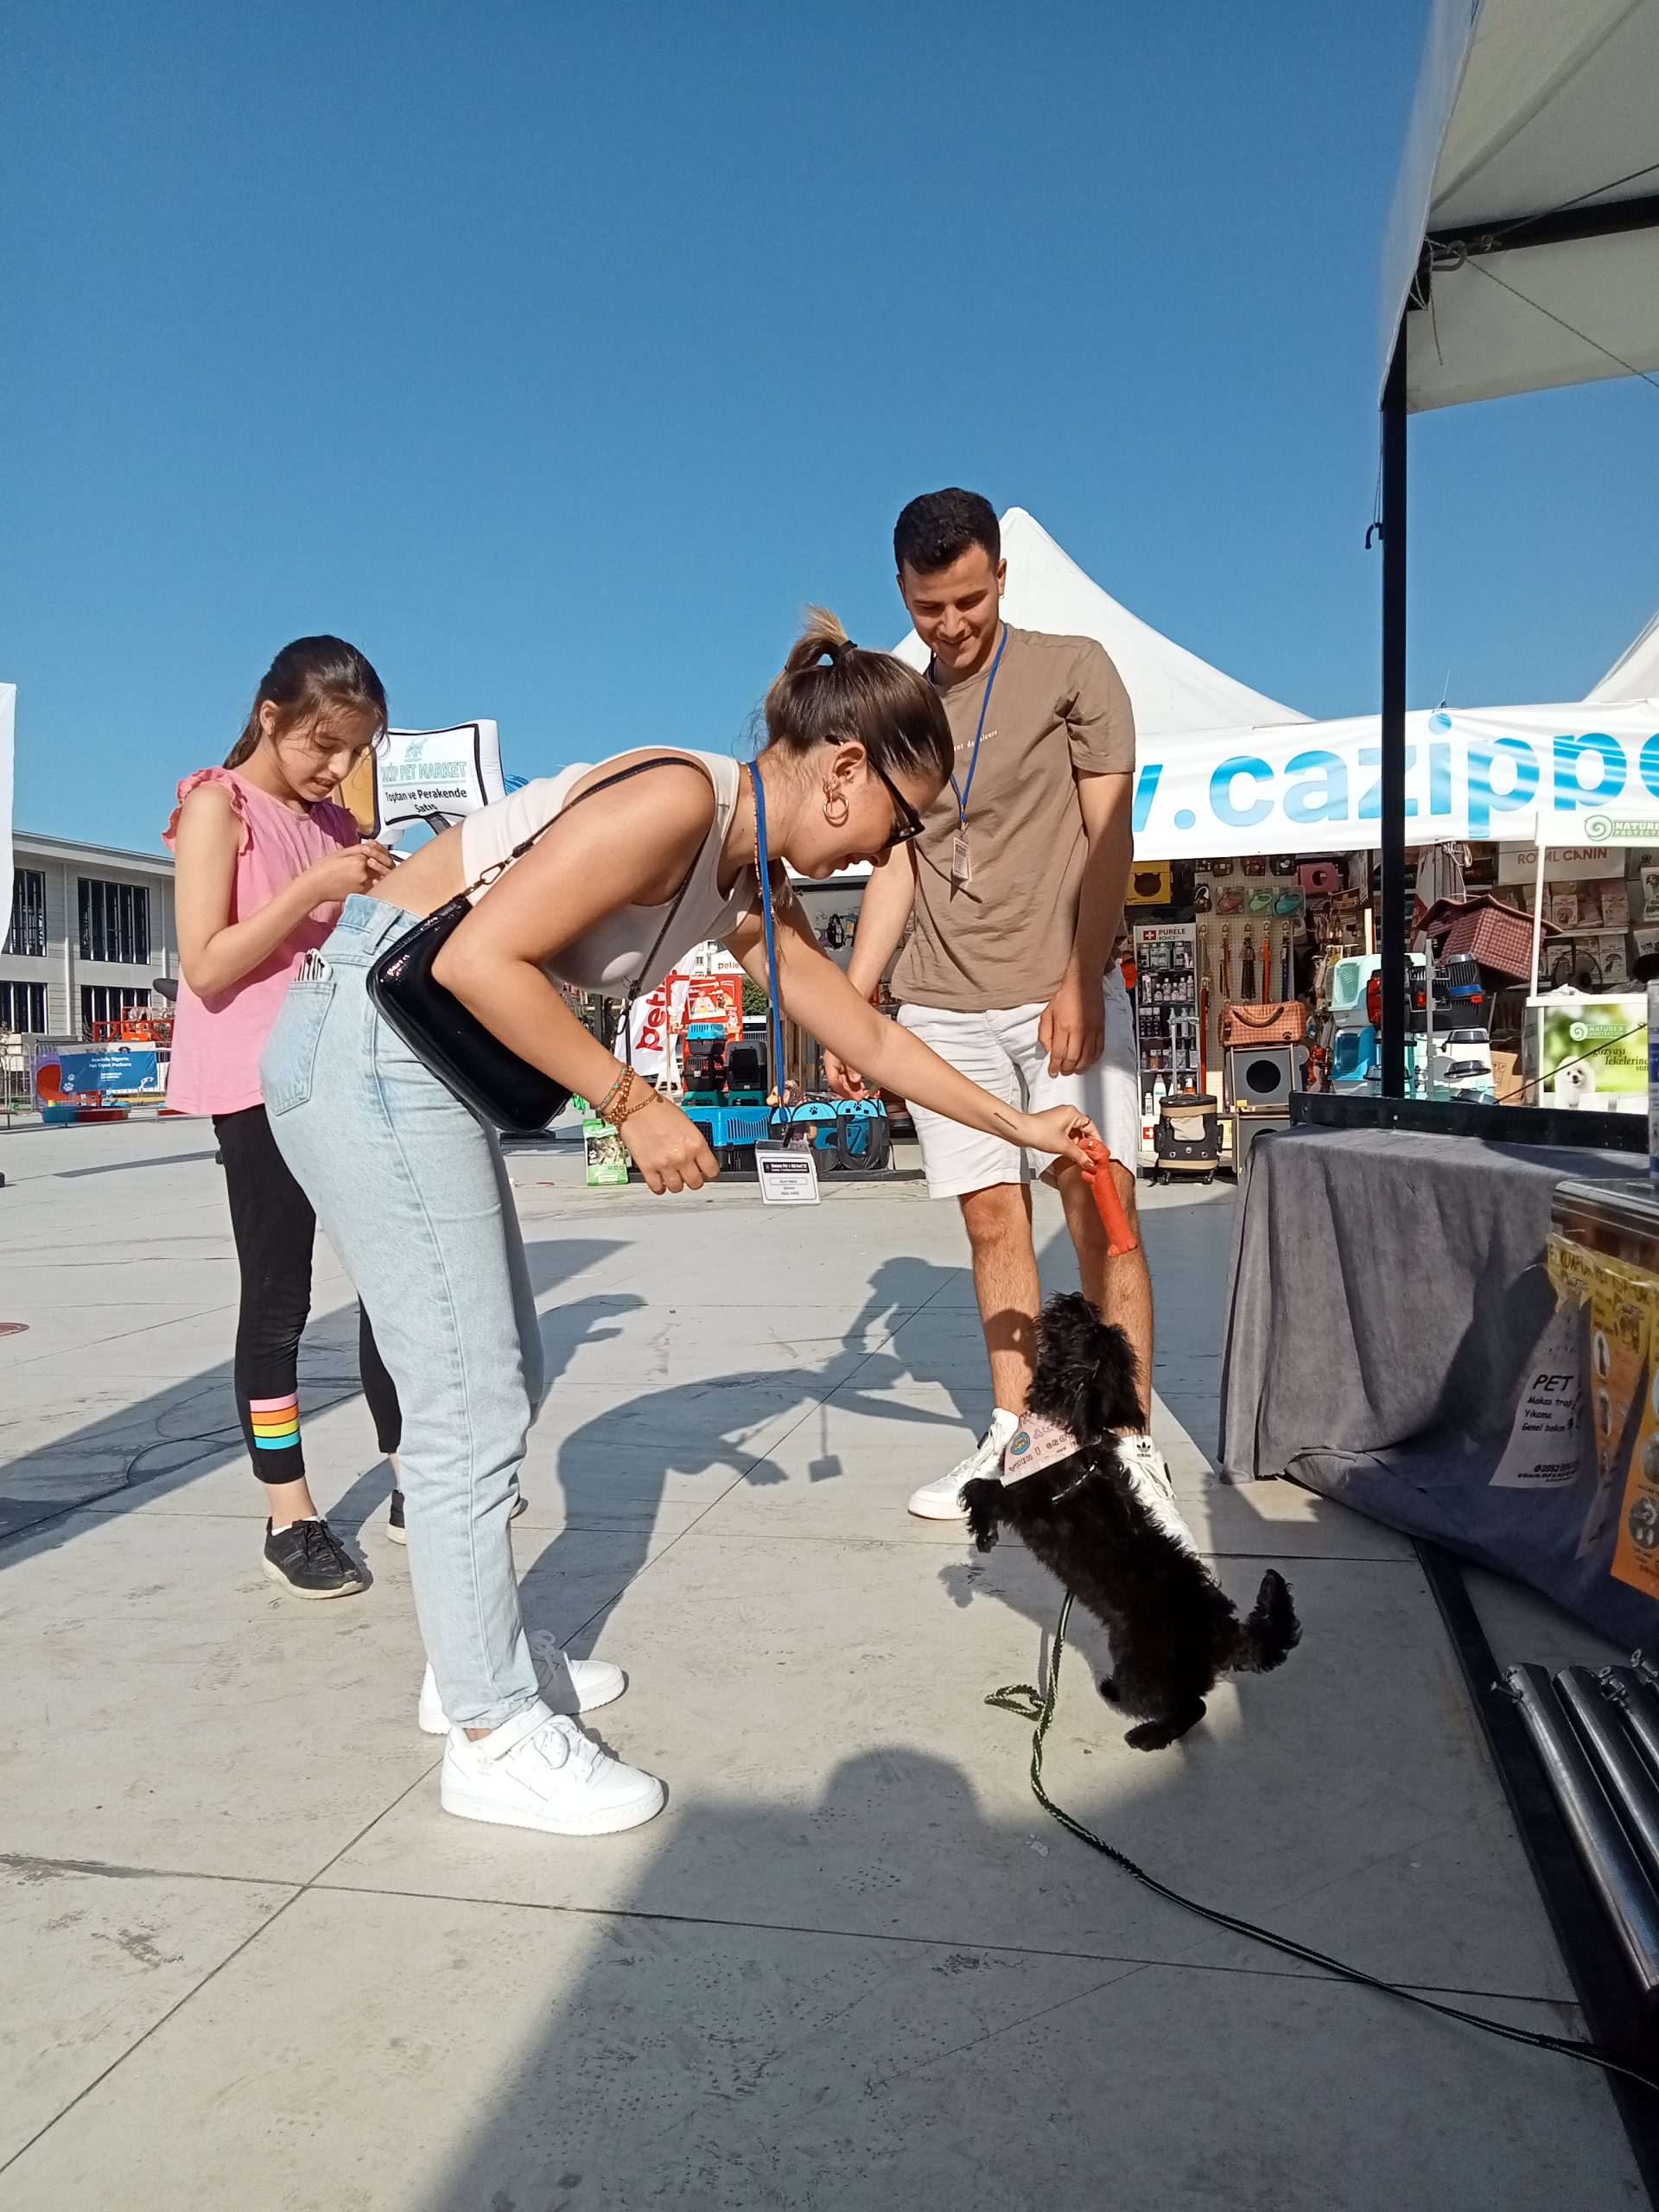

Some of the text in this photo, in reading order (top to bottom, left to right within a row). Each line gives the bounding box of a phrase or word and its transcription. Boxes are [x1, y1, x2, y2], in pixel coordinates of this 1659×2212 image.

[400, 764, 416, 780] PET
[419, 761, 467, 779] MARKET
[1132, 713, 1659, 839] .cazipp
[385, 787, 467, 804] Toptan ve Perakende
[414, 804, 438, 813] Satış
[1517, 848, 1608, 864] ROAL CANIN
[1532, 1374, 1574, 1391] PET
[1527, 1396, 1553, 1406] Makas
[1522, 1423, 1542, 1432] Genel
